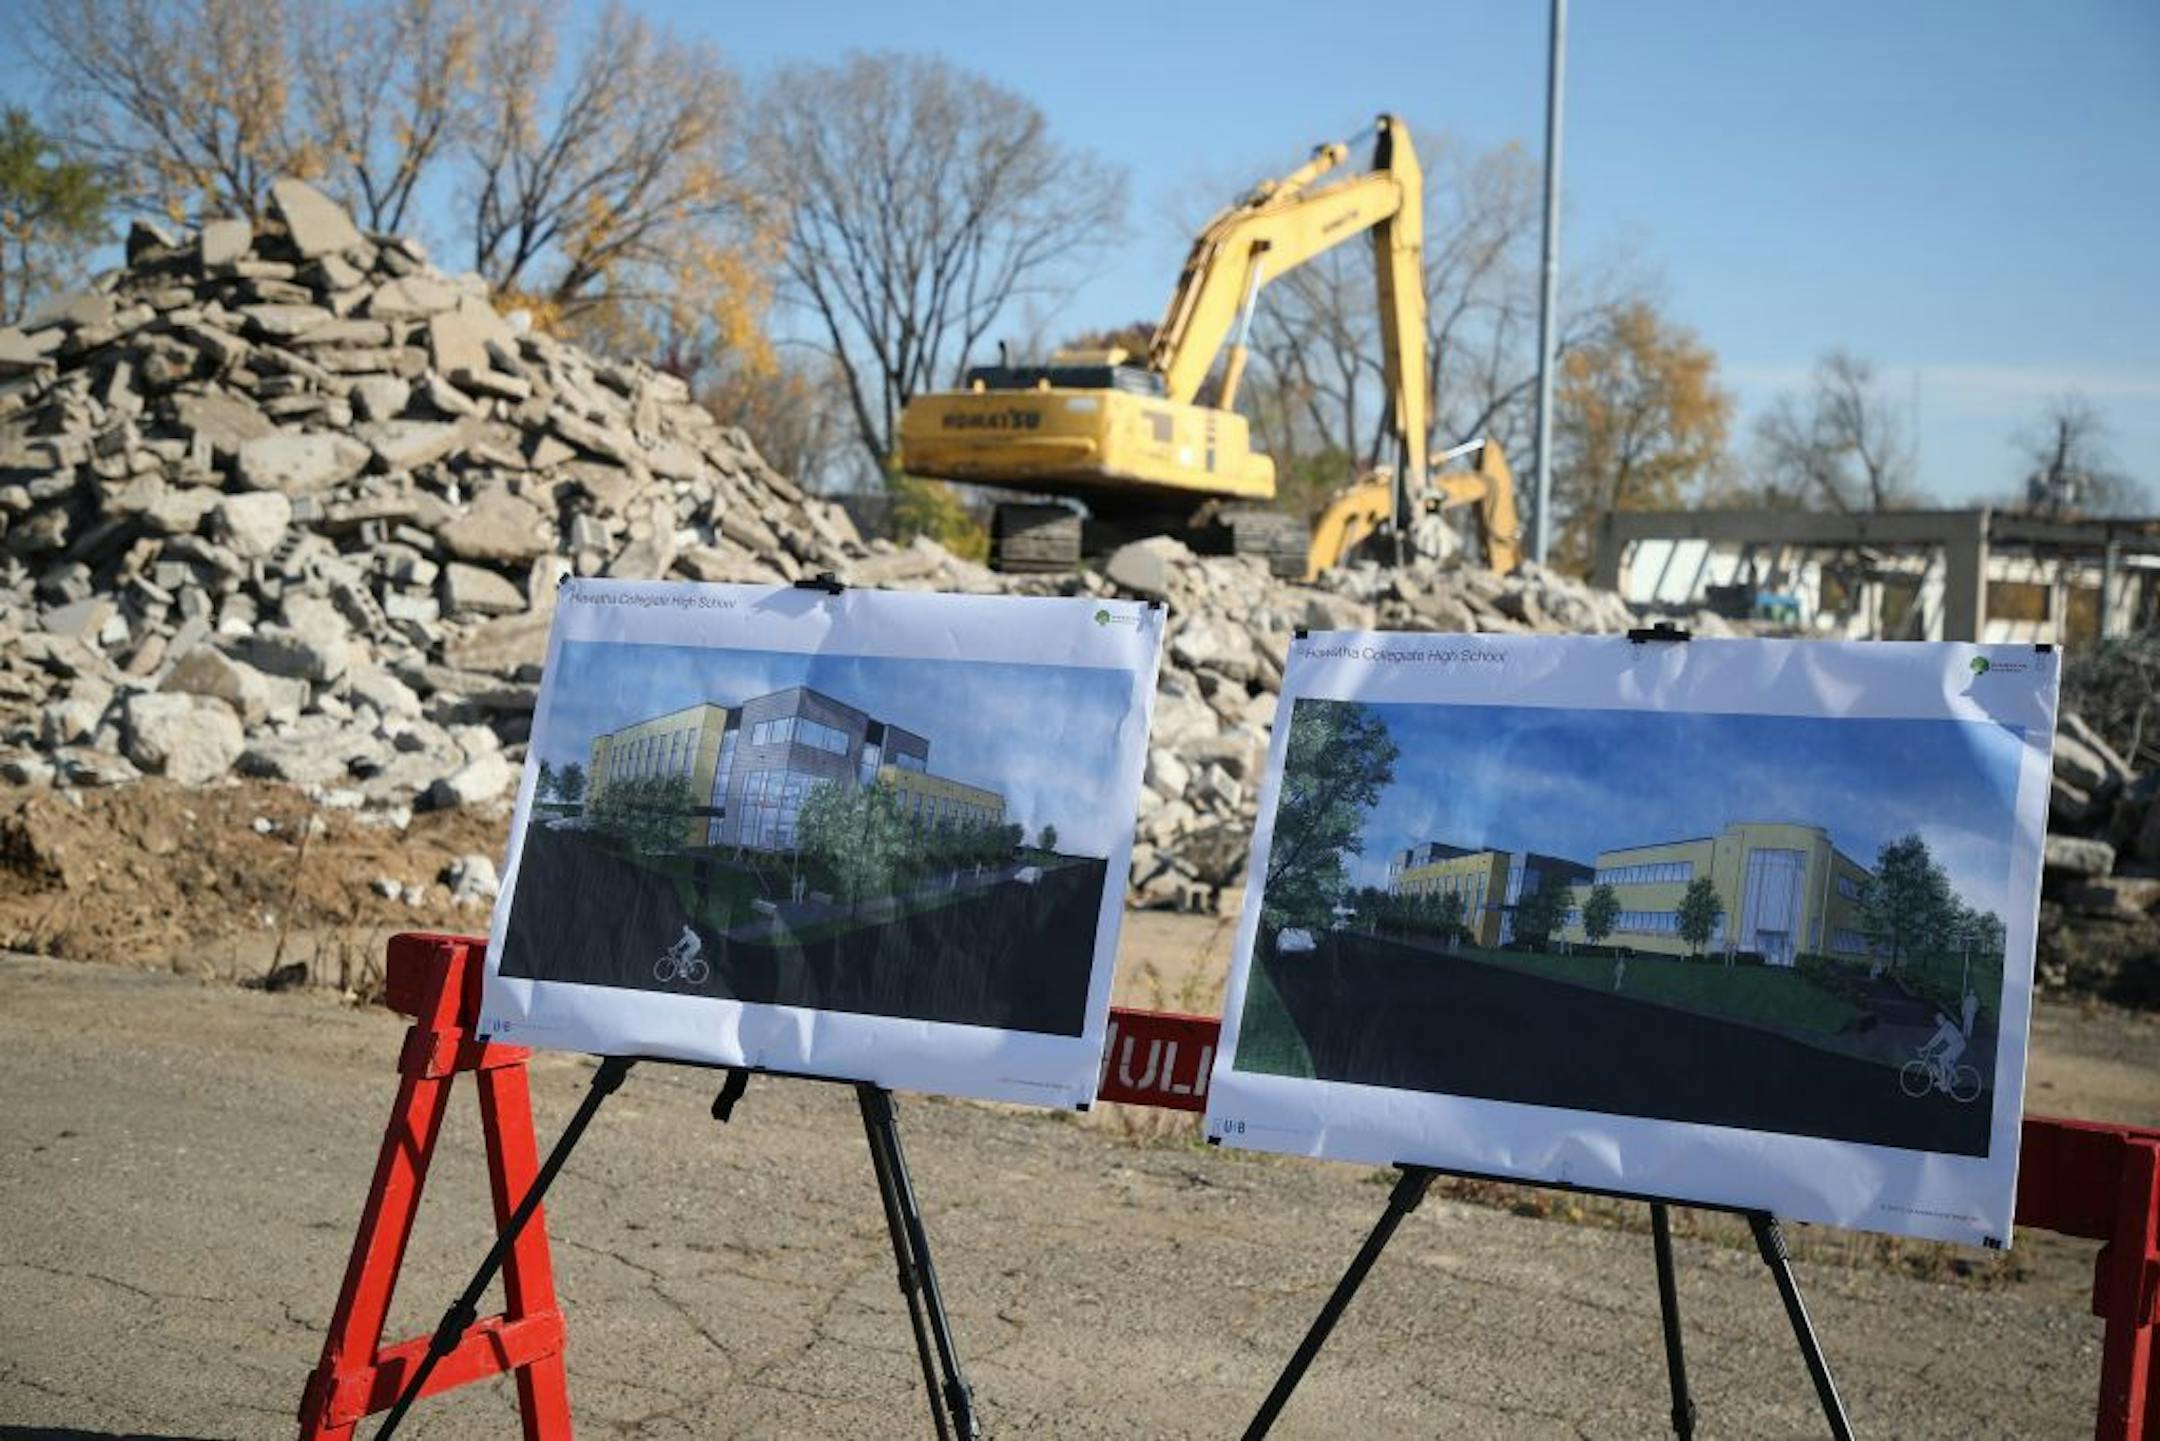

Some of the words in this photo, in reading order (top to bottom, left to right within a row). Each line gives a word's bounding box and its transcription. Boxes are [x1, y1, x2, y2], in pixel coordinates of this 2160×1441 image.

[672, 596, 697, 609] High
[699, 597, 736, 609] School
[1362, 647, 1424, 663] Collegiate
[1428, 649, 1457, 664] High
[1461, 650, 1507, 663] School
